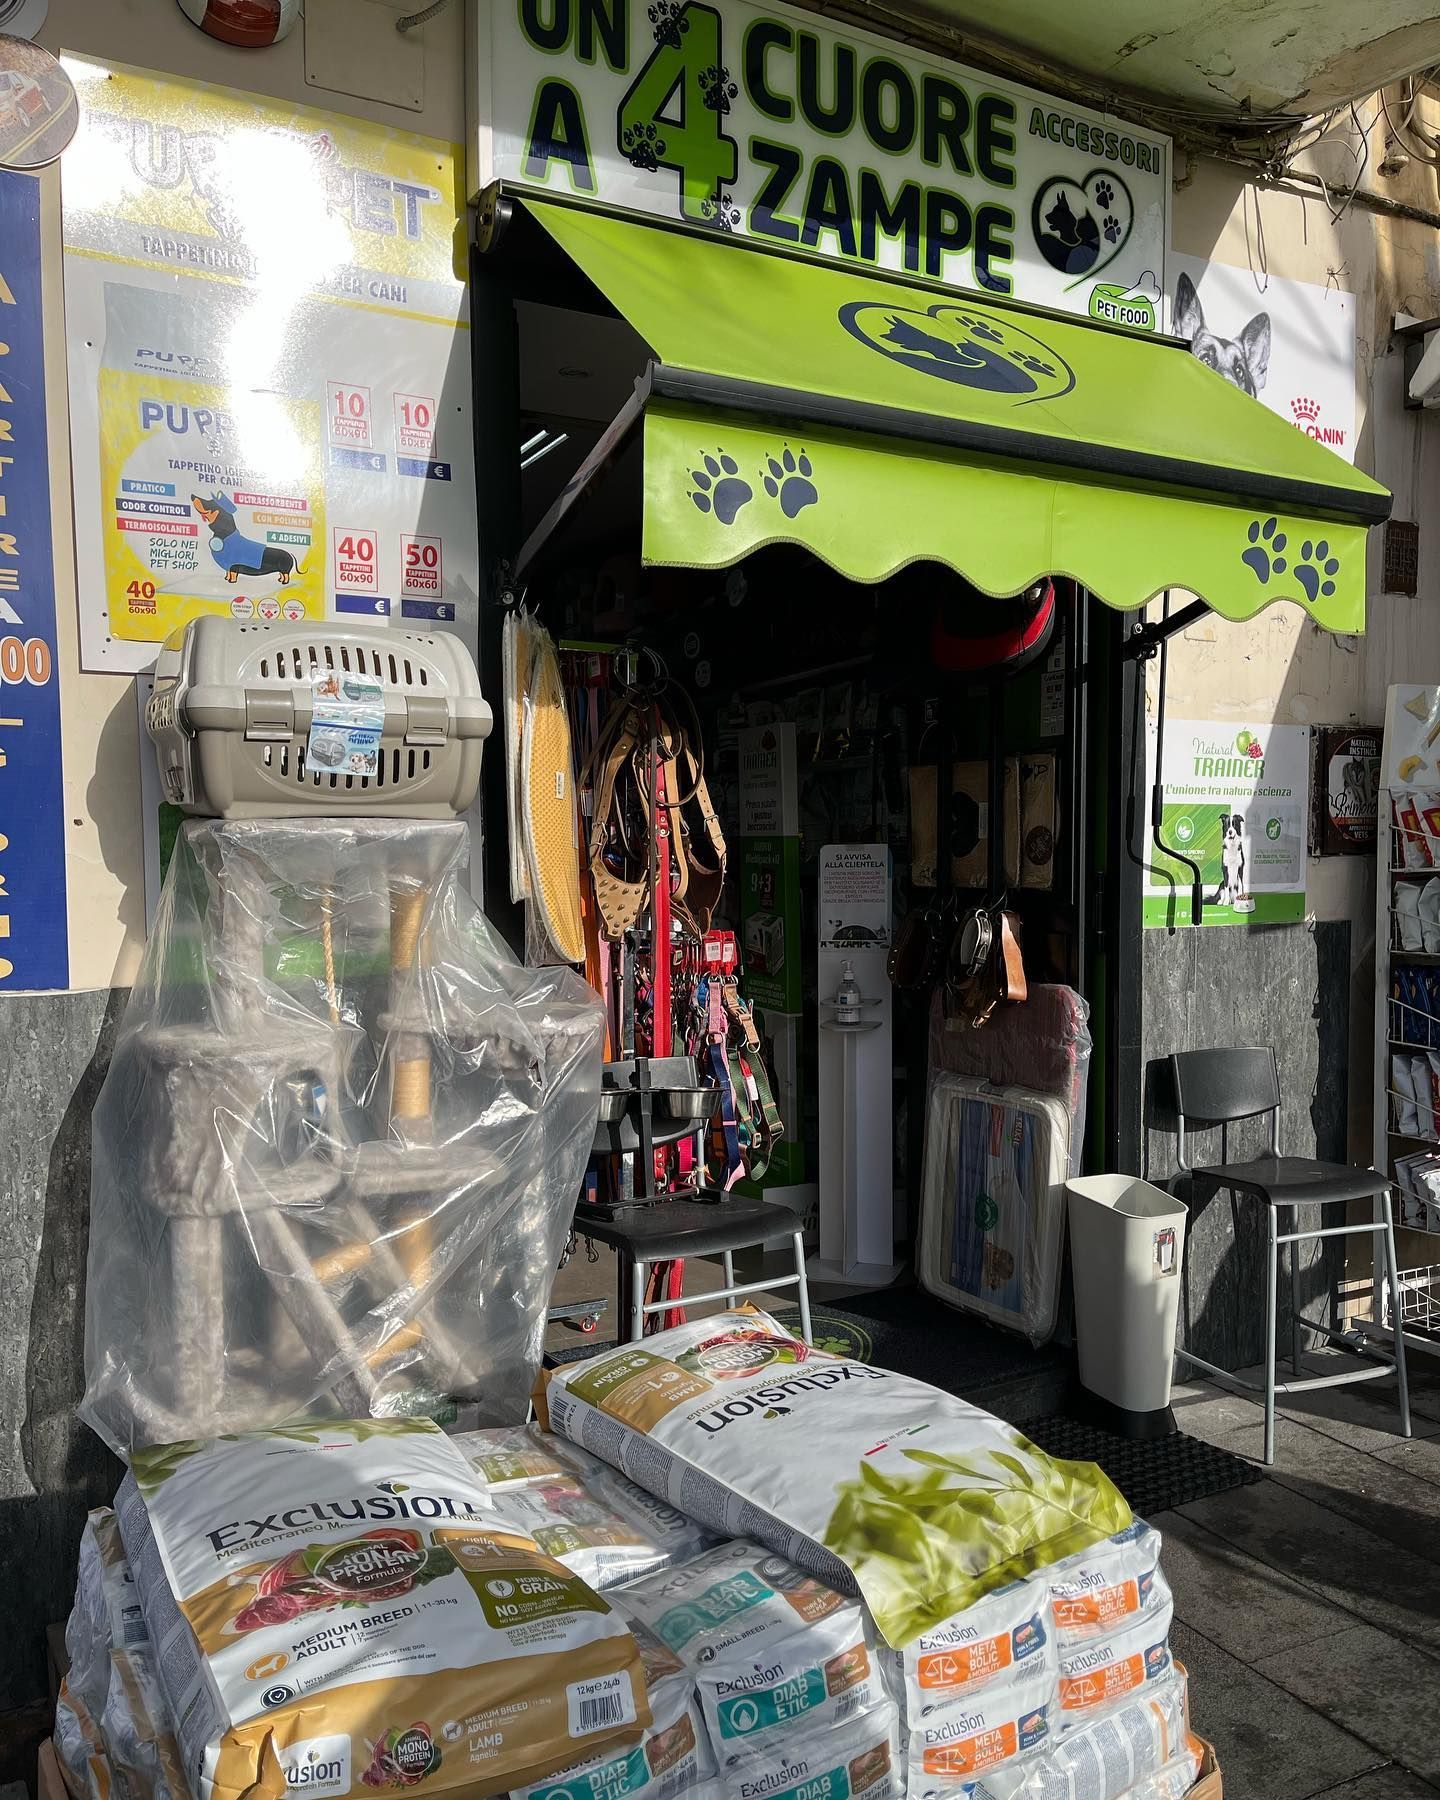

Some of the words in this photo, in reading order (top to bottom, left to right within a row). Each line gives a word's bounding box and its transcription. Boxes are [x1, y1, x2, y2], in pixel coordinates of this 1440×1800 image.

[521, 0, 630, 75] UN
[741, 17, 1017, 190] CUORE
[521, 76, 597, 195] A
[617, 0, 739, 222] 4
[746, 136, 1015, 295] ZAMPE
[1029, 107, 1160, 175] ACCESSORI
[367, 280, 408, 303] CANI
[1097, 299, 1118, 320] PET
[1120, 305, 1149, 325] FOOD
[335, 390, 365, 418] 10
[141, 400, 237, 435] PUPP
[400, 401, 430, 428] 10
[1306, 425, 1344, 446] CANIN
[168, 458, 222, 475] TAPPETINO
[369, 456, 381, 470] €
[433, 466, 444, 478] €
[130, 482, 166, 493] PRATICO
[198, 473, 216, 484] PER
[122, 501, 146, 512] ODOR
[148, 503, 186, 515] CONTROL
[238, 495, 303, 509] ULTRASSORBENTE
[124, 520, 191, 534] TERMOISOLANTE
[150, 537, 178, 549] SOLO
[181, 540, 198, 551] NEI
[271, 533, 277, 541] 4
[278, 533, 307, 543] ADESIVI
[150, 549, 194, 560] MIGLIORI
[337, 536, 374, 562] 40
[406, 543, 438, 568] 50
[150, 559, 170, 570] PET
[172, 560, 199, 571] SHOP
[342, 563, 371, 573] TAPPETINI
[406, 569, 437, 580] TAPPETINI
[339, 572, 373, 584] 60x90
[405, 578, 438, 590] 60x60
[126, 580, 156, 600] 40
[128, 606, 157, 615] 60x90
[374, 600, 385, 613] €
[436, 605, 446, 618] €
[1192, 737, 1235, 756] Natural
[1349, 747, 1377, 756] INSTINCT
[1350, 738, 1377, 748] NATURAL
[1192, 757, 1266, 779] TRAINER
[1165, 783, 1206, 797] L'unione
[1223, 786, 1253, 797] natura
[1258, 786, 1292, 797] scienza
[824, 861, 844, 869] ALLA
[844, 853, 872, 861] AVVISA
[713, 1346, 773, 1369] MONO
[592, 1365, 628, 1388] GRAIN
[731, 1374, 794, 1398] Monoprotein
[668, 1383, 704, 1402] LAMB
[695, 1364, 892, 1433] Exclusion
[686, 1393, 733, 1422] Formula
[205, 1495, 477, 1553] Exclusion
[216, 1522, 324, 1561] Mediterraneo
[330, 1553, 421, 1582] PROTEIN
[356, 1566, 405, 1584] Formula
[520, 1581, 571, 1595] GRAIN
[1051, 1572, 1105, 1597] Exclusion
[1099, 1585, 1125, 1603] META
[494, 1603, 519, 1618] NO
[1099, 1597, 1126, 1616] BOLIC
[292, 1621, 359, 1653] MEDIUM
[360, 1607, 414, 1629] BREED
[421, 1599, 446, 1610] 11-30
[447, 1597, 458, 1606] kg
[506, 1627, 526, 1636] WITH
[508, 1631, 528, 1640] OLIVE
[542, 1622, 557, 1630] AND
[557, 1618, 578, 1627] HEMP
[714, 1635, 742, 1652] SMALL
[741, 1624, 766, 1640] BREED
[920, 1626, 978, 1651] Exclusion
[295, 1637, 348, 1662] ADULT
[969, 1639, 997, 1657] META
[969, 1651, 999, 1672] BOLIC
[972, 1662, 1001, 1678] MOBILITY
[1062, 1646, 1114, 1675] Exclusion
[1104, 1661, 1131, 1679] META
[715, 1662, 786, 1696] Exclusion
[1105, 1671, 1132, 1688] BOLIC
[576, 1686, 586, 1696] 12
[585, 1683, 595, 1695] kg
[773, 1678, 809, 1705] DIAB
[465, 1709, 499, 1725] MEDIUM
[499, 1702, 529, 1716] BREED
[776, 1694, 811, 1720] ETIC
[467, 1720, 494, 1736] ADULT
[925, 1714, 985, 1744] Exclusion
[397, 1740, 429, 1756] MONO
[469, 1733, 503, 1752] LAMB
[974, 1729, 1002, 1750] META
[398, 1750, 431, 1765] PROTEIN
[470, 1749, 499, 1764] Agnello
[975, 1743, 1003, 1761] BOLIC
[977, 1751, 1006, 1768] MOBILITY
[288, 1760, 342, 1784] usion
[589, 1760, 629, 1791] DIAB
[741, 1760, 810, 1797] Exclusion
[317, 1778, 341, 1788] Formula
[796, 1776, 832, 1800] DIAB
